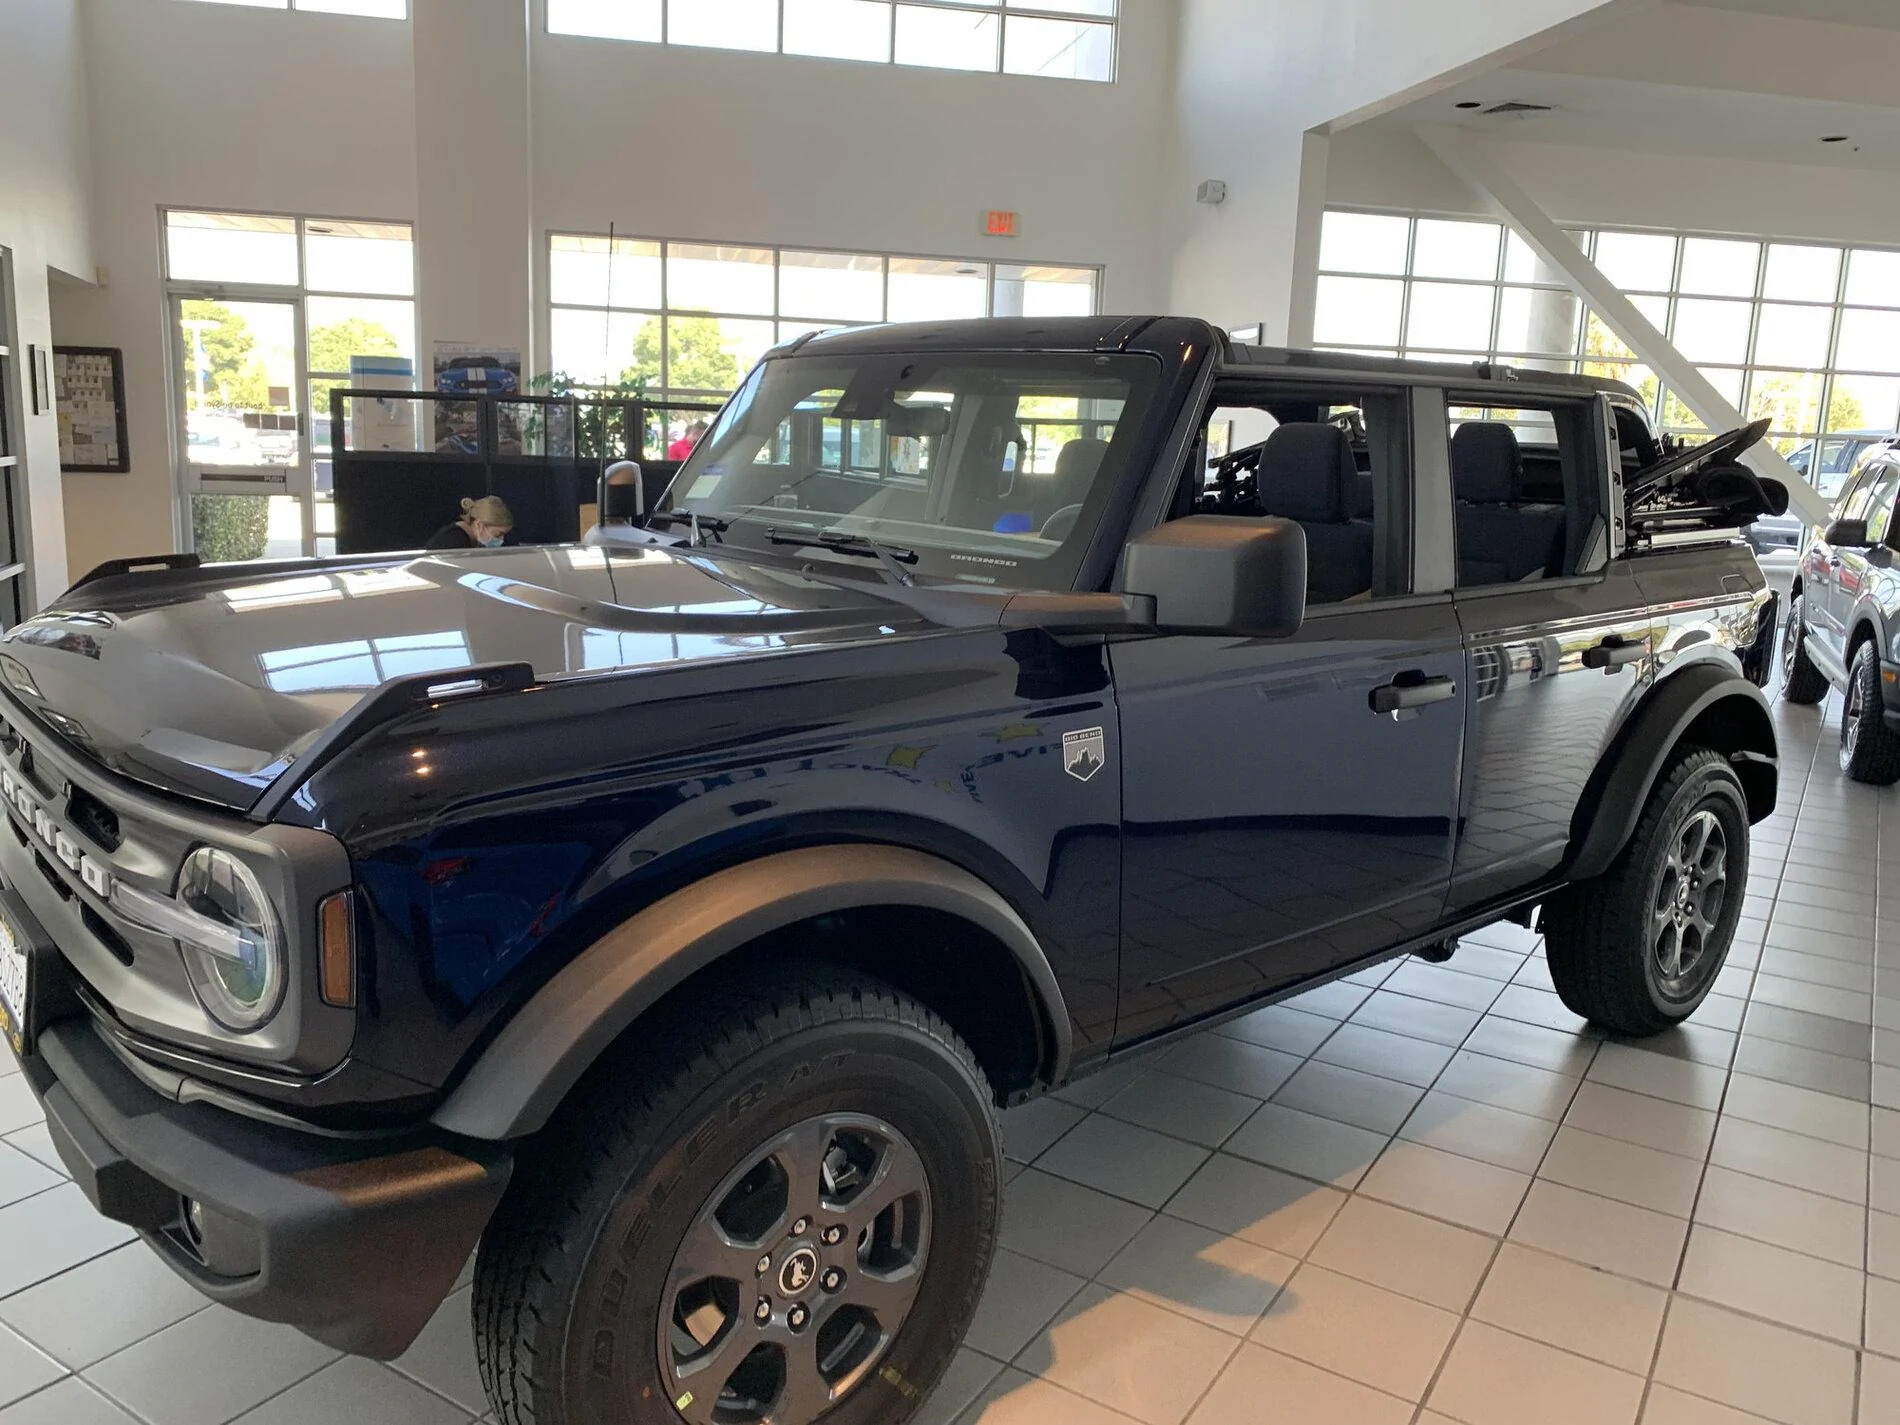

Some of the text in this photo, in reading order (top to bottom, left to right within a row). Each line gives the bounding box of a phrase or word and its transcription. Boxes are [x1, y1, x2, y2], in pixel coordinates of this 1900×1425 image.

[987, 210, 1014, 234] EXIT
[950, 554, 1018, 566] BRONCO
[1065, 730, 1101, 742] BIG BEND
[2, 769, 111, 898] RONCO
[592, 1079, 769, 1378] DUELER
